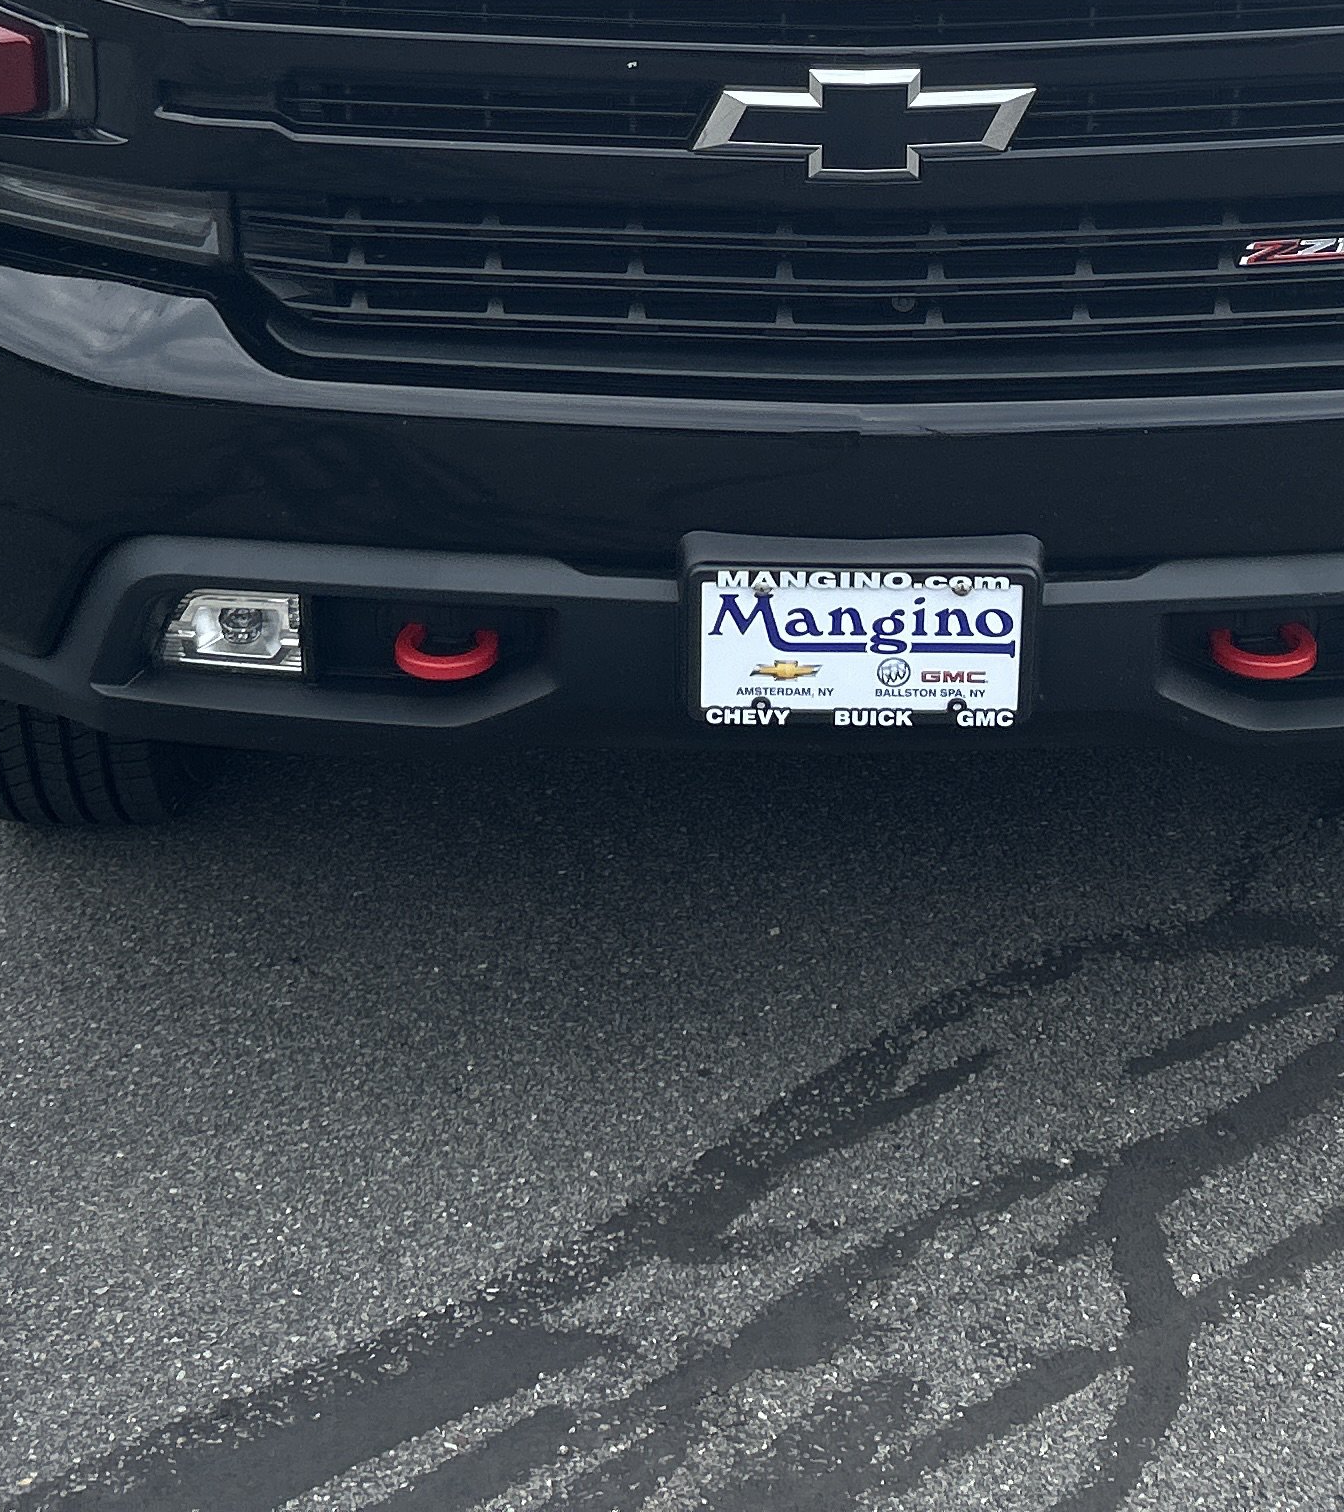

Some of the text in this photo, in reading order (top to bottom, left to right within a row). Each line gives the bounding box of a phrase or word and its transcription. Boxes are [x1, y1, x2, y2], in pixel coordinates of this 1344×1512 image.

[717, 570, 1011, 590] MANGINO.com
[708, 593, 1016, 656] Mangino
[921, 670, 988, 684] GMC
[736, 687, 834, 698] AMSTERDAM, NY
[875, 688, 937, 698] BALLSTON
[969, 688, 986, 698] NY
[706, 708, 1014, 727] CHEVY BUICK GMC
